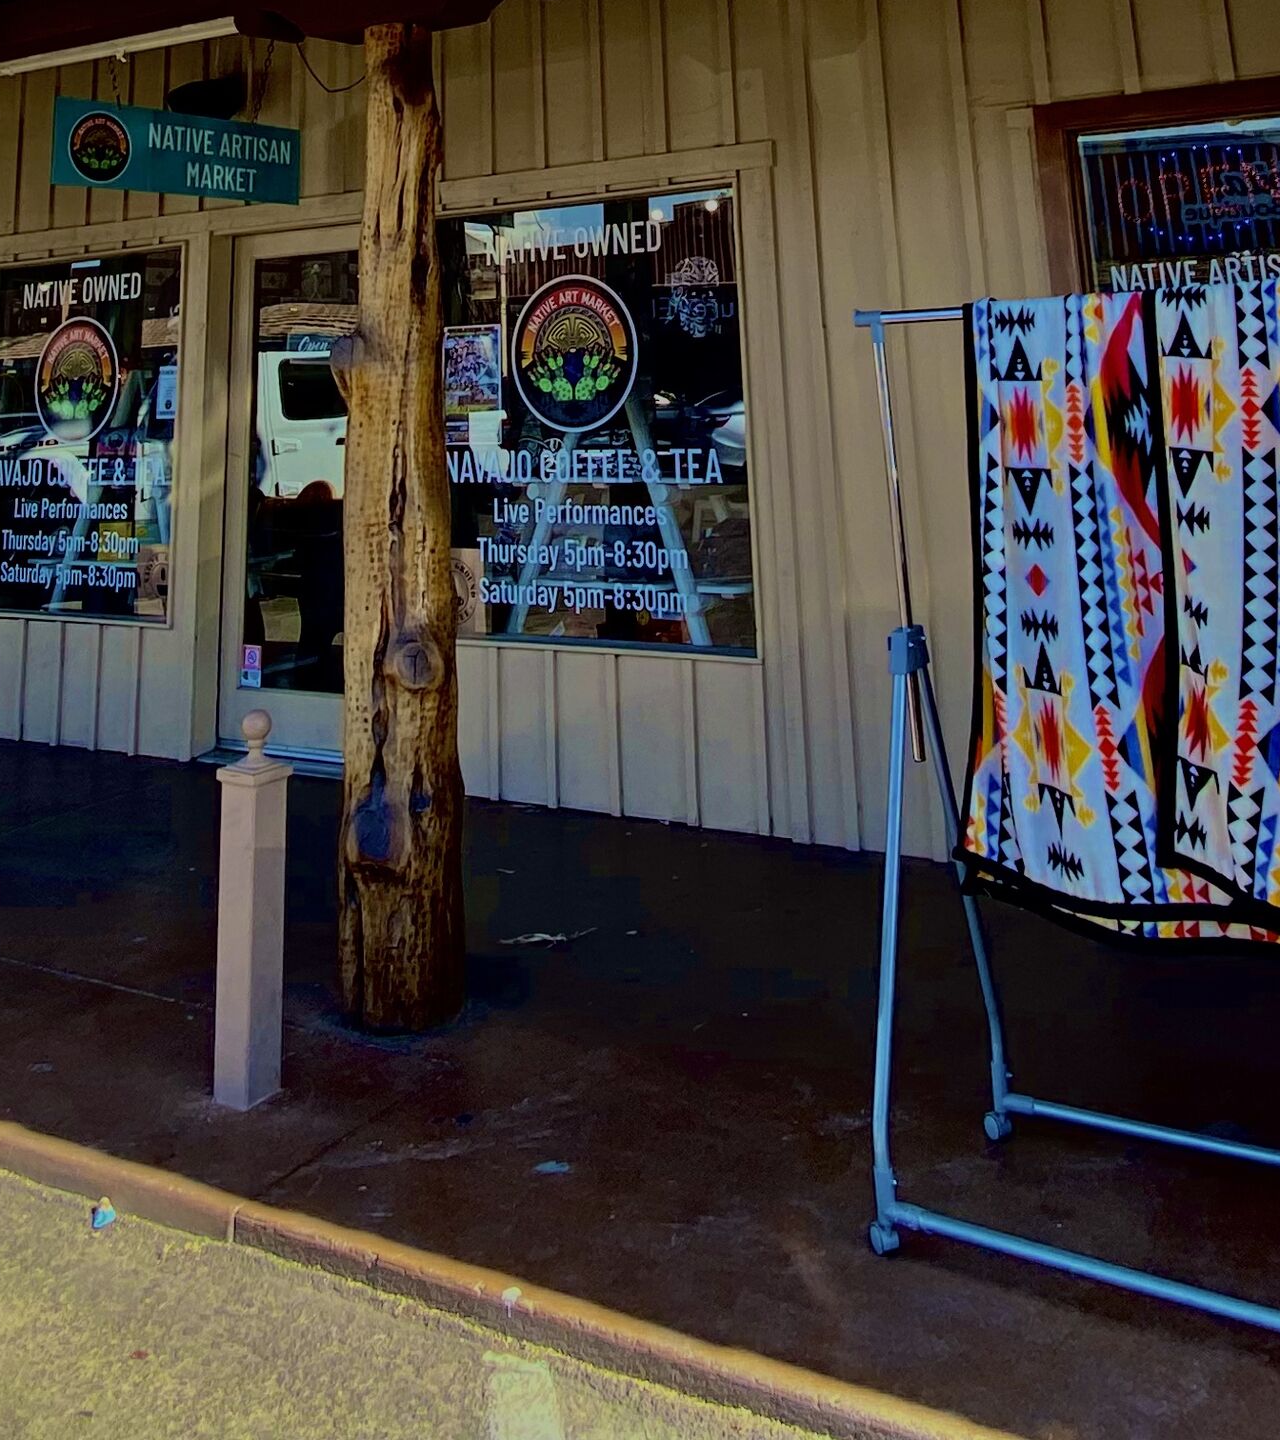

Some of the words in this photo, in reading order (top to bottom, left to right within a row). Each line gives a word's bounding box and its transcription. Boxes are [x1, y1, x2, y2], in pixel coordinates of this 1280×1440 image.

[148, 122, 215, 155] NATIVE
[220, 132, 291, 165] ARTISAN
[186, 161, 257, 192] MARKET
[486, 228, 566, 266] NATIVE
[574, 221, 662, 258] OWNED
[23, 278, 78, 310] NATIVE
[82, 272, 142, 304] OWNED
[1111, 260, 1197, 293] NATIVE
[527, 296, 557, 333] NATIVE
[559, 291, 578, 304] ART
[581, 292, 620, 327] MARKET
[47, 458, 108, 486] COEE
[113, 457, 126, 486] &
[446, 449, 531, 483] NAVAJO
[540, 449, 632, 483] COFFEE
[641, 448, 660, 483] &
[674, 448, 723, 483] TEA
[14, 497, 38, 519] Live
[41, 497, 128, 520] Performances
[494, 498, 528, 524] Live
[534, 498, 668, 525] Performances
[2, 529, 56, 556] Thursday
[58, 530, 138, 558] 5pm-8:30pm
[477, 537, 559, 572] Thursday
[564, 539, 688, 575] 5pm-8:30pm
[0, 562, 52, 589] Saturday
[55, 564, 136, 592] 5pm-8:30pm
[479, 578, 559, 613] Saturday
[563, 581, 688, 614] 5pm-8:30pm
